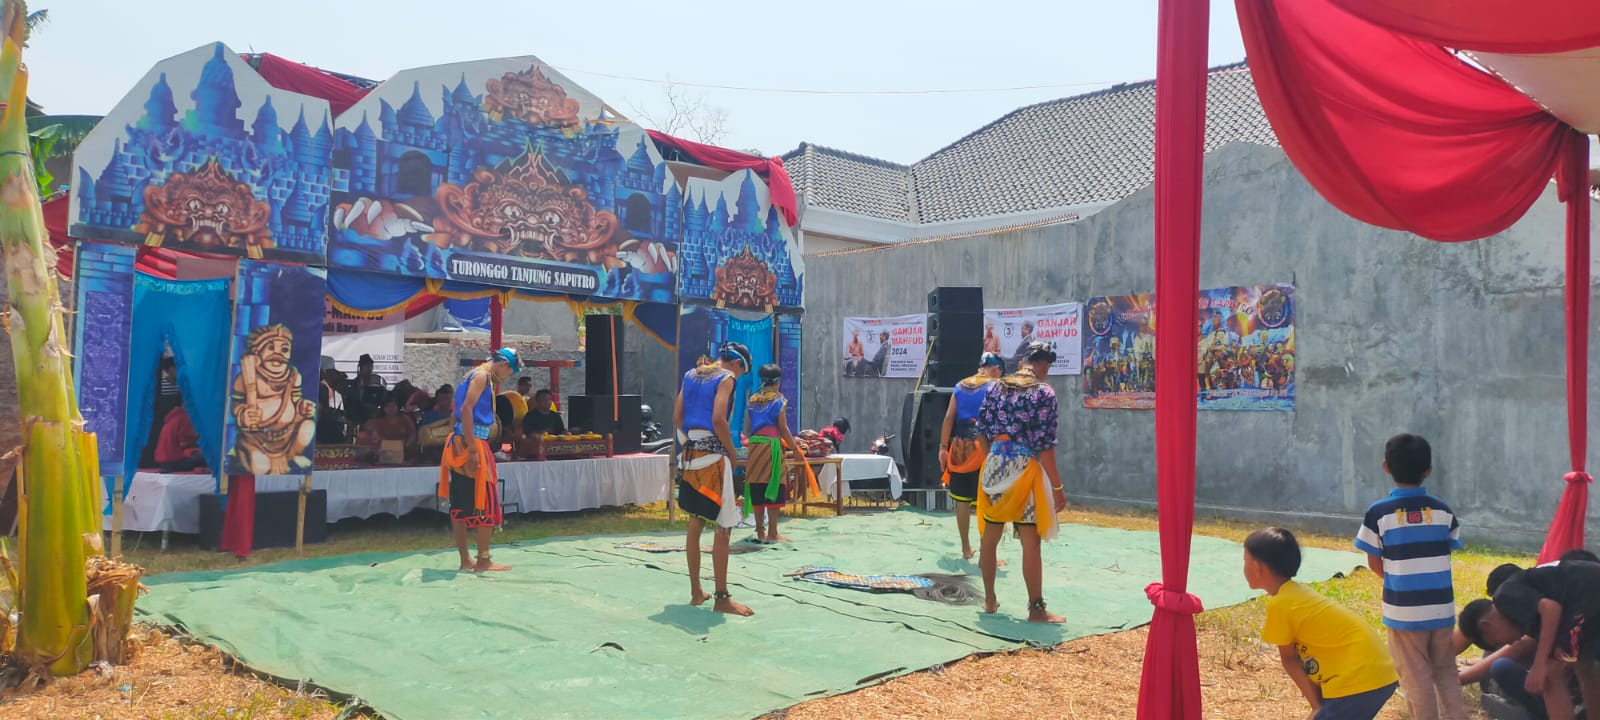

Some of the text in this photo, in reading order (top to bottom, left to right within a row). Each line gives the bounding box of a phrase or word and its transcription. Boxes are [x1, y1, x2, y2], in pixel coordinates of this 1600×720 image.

[452, 259, 595, 289] TURONGGO TANJUNG SAPUTRO
[1037, 317, 1077, 328] GANJAR
[892, 326, 923, 336] GANJAR
[1036, 328, 1078, 339] MAHFUD
[891, 337, 924, 346] MAHFUD
[891, 347, 907, 355] 2024
